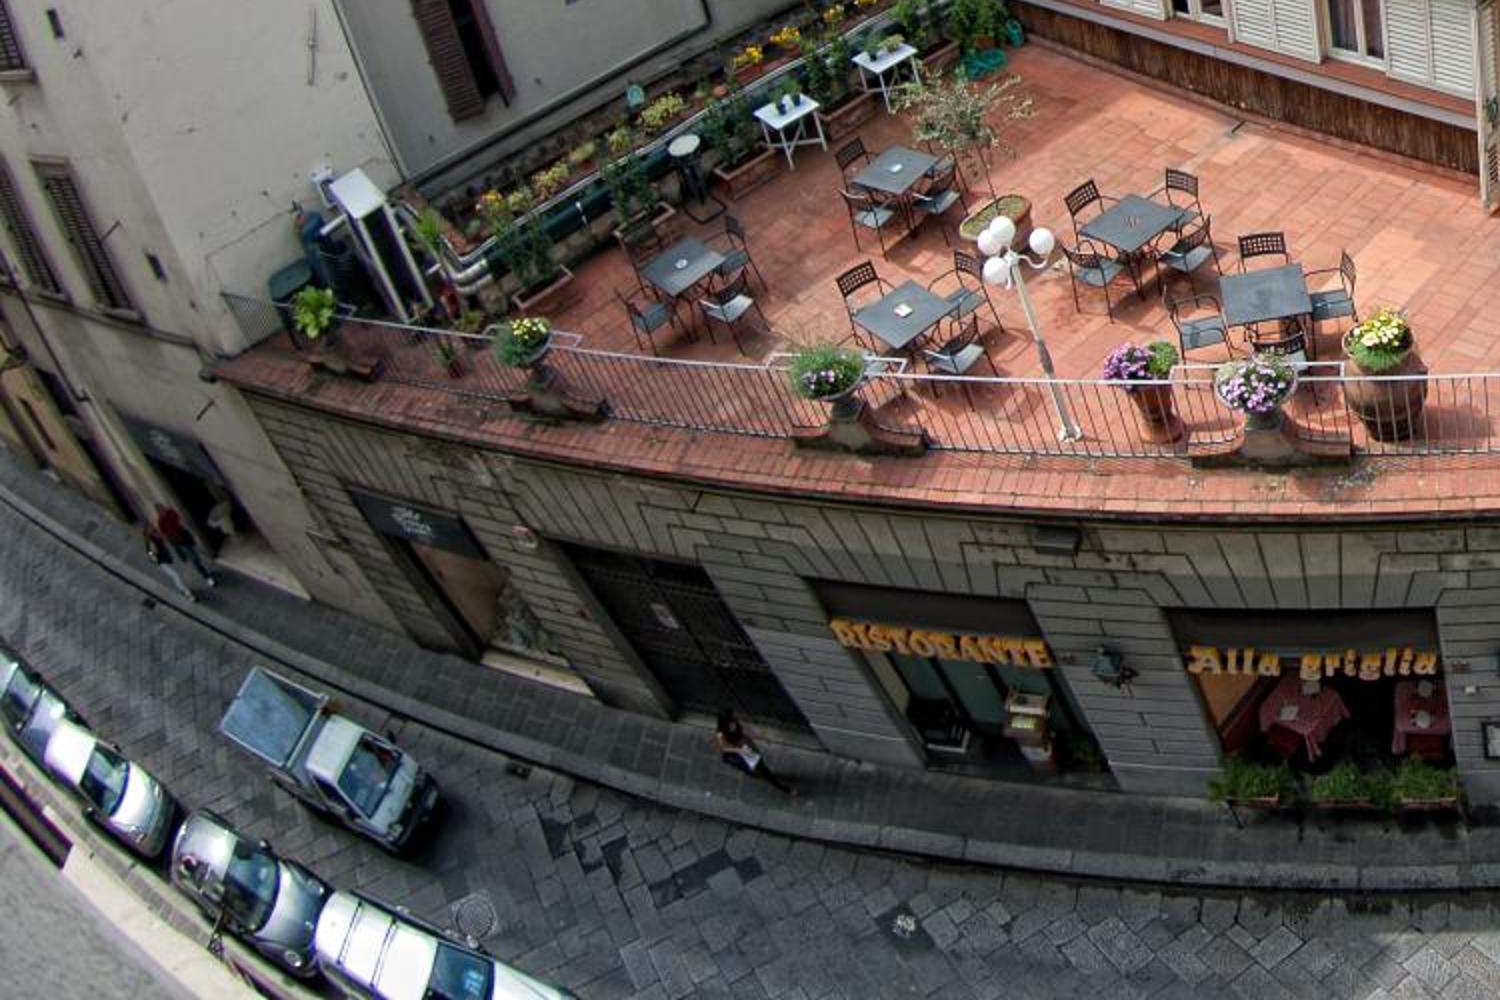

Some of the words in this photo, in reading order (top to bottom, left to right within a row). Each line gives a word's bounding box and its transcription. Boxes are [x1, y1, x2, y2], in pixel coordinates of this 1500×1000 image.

[830, 617, 1052, 668] RISTORANTE
[1187, 644, 1282, 676] Alla
[1299, 648, 1437, 681] griglia
